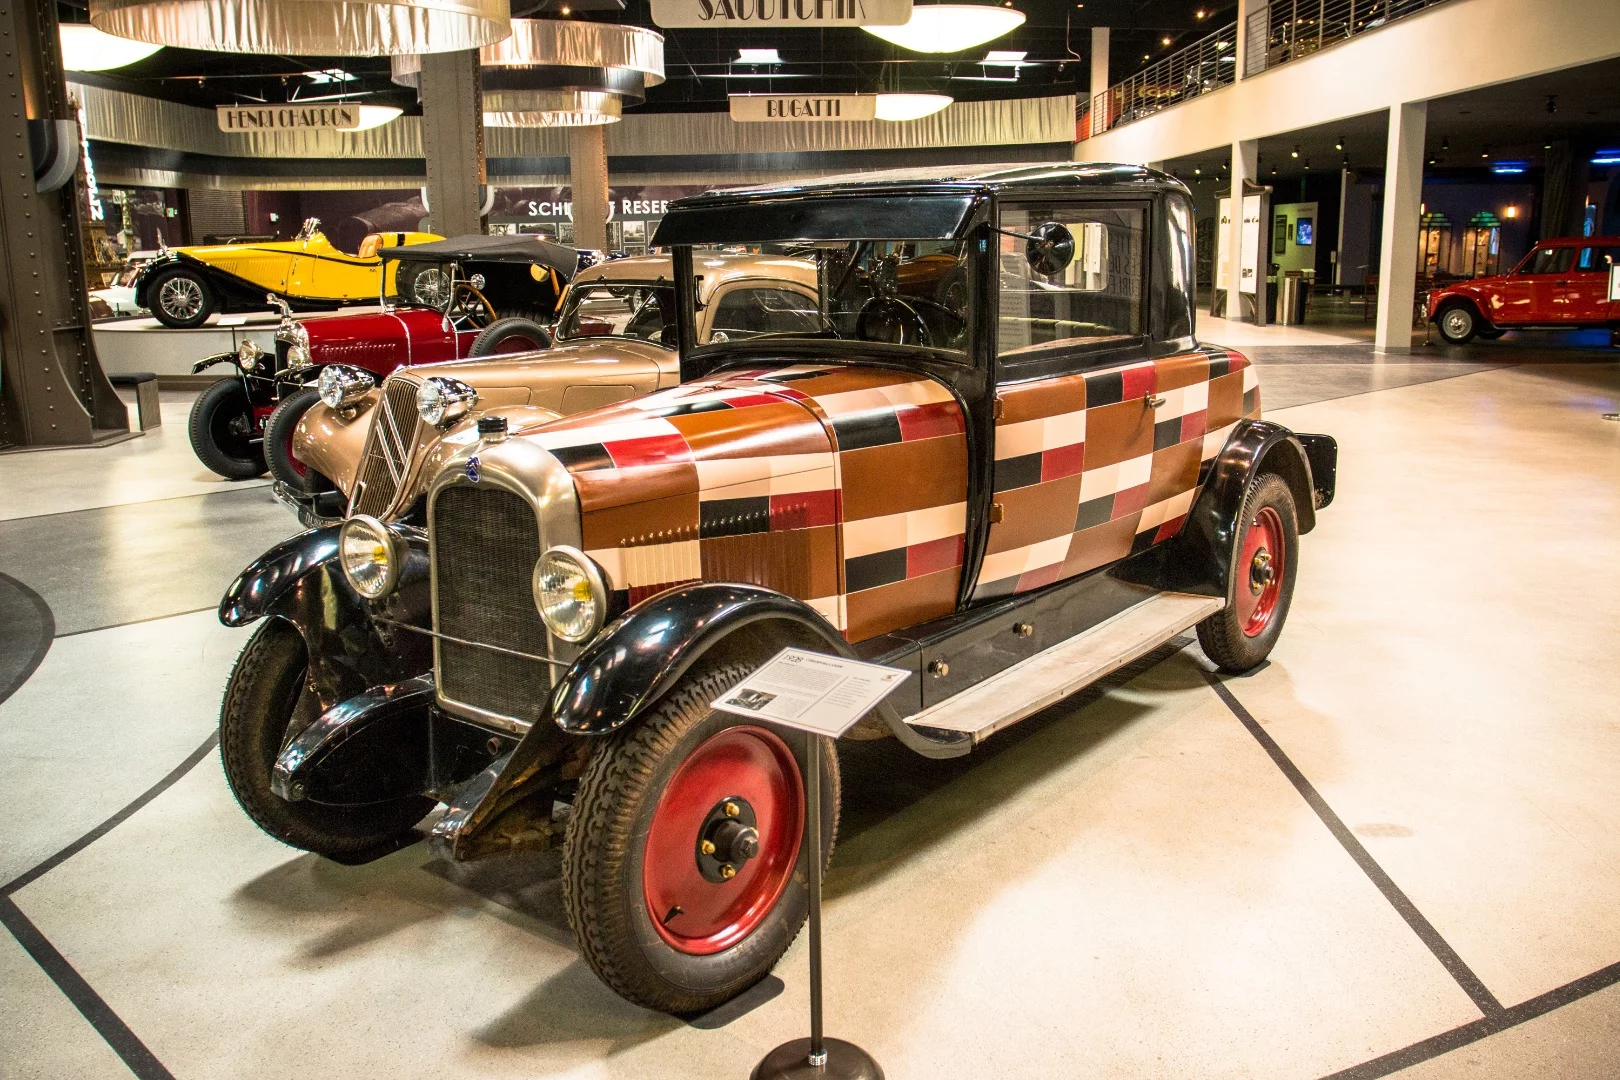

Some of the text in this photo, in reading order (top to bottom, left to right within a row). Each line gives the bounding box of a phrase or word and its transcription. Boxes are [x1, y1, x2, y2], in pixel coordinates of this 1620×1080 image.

[227, 107, 352, 129] HENRI CHAPRON
[767, 99, 841, 118] BUGATTI
